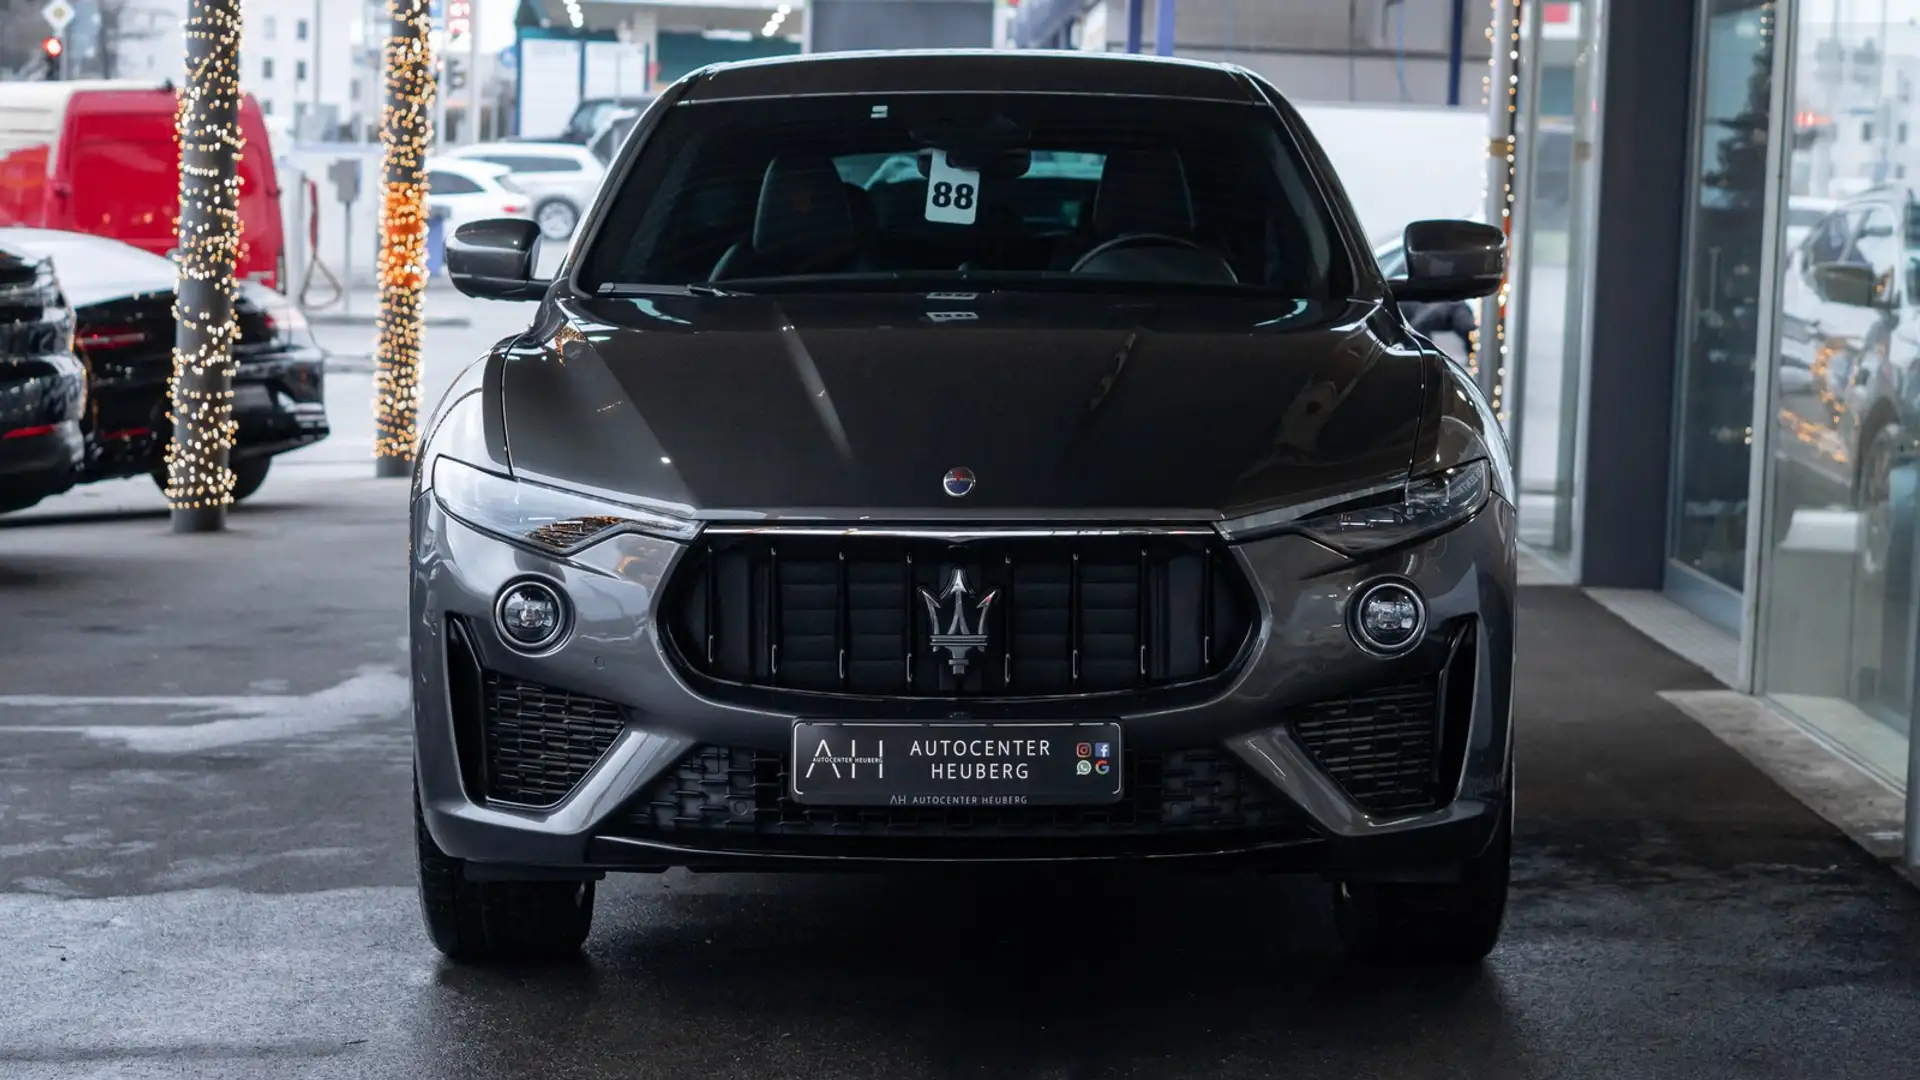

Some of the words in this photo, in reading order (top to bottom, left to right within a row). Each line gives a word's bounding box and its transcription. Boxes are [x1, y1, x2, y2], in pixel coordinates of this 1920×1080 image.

[932, 182, 975, 210] 88
[910, 739, 1050, 756] AUTOCENTER
[805, 739, 883, 779] AH
[813, 756, 853, 764] AUTOCENTER
[854, 756, 883, 764] HEUBERG
[931, 763, 1029, 779] HEUBERG
[912, 795, 978, 805] AUTOCENTER
[981, 795, 1028, 805] HEUBERG
